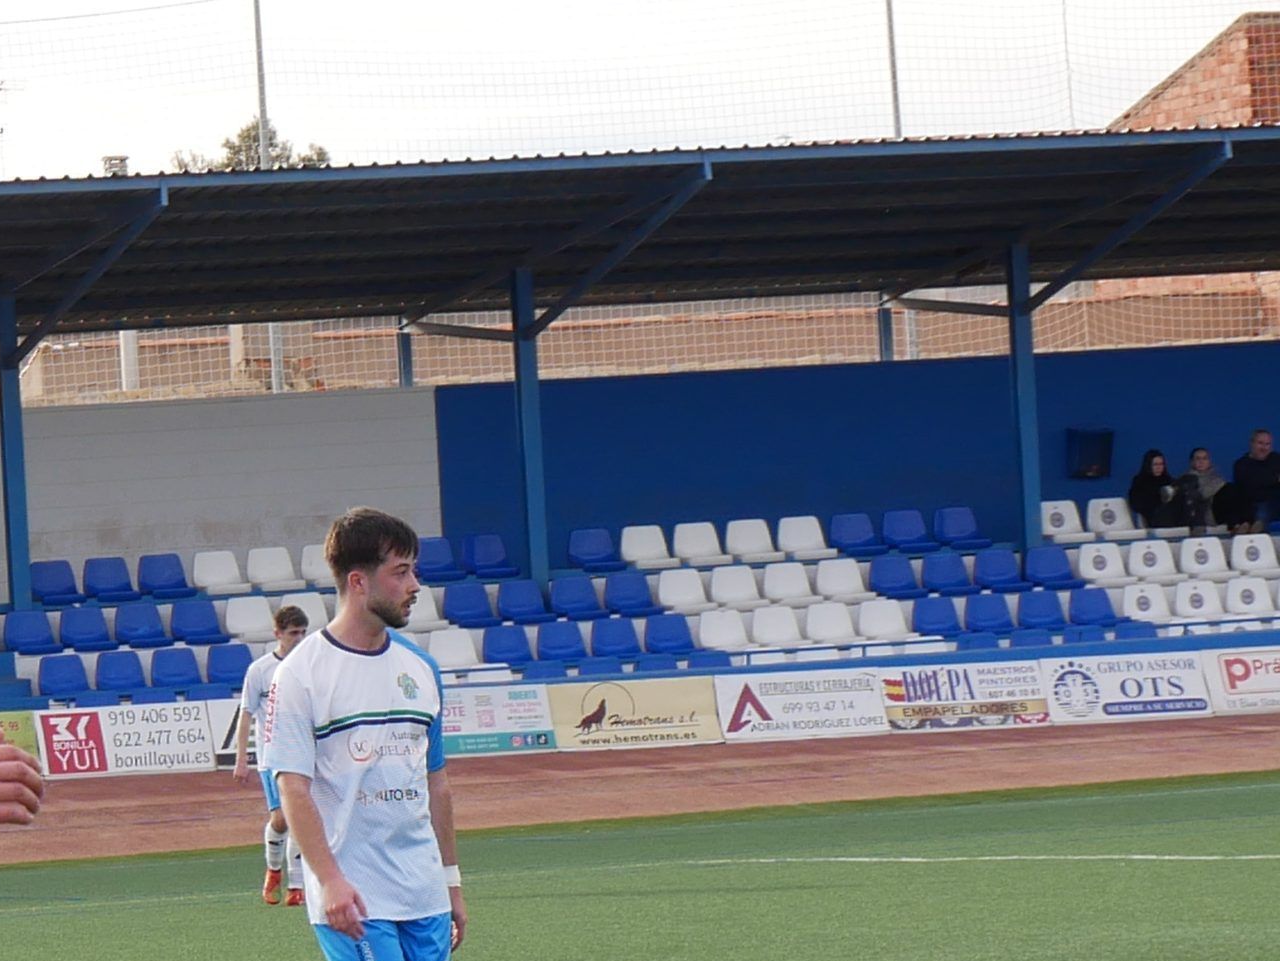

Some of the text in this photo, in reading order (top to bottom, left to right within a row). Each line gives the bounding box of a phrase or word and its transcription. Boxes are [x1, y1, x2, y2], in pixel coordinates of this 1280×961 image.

[977, 666, 1035, 675] MAESTROS
[1097, 658, 1196, 674] GRUPO ASESOR
[759, 681, 814, 693] ESTRUCTURAS
[978, 675, 1037, 686] PINTORES
[1120, 675, 1185, 699] OTS
[108, 706, 201, 725] 919 406 592
[902, 702, 1029, 718] EMPAPELADORES
[53, 741, 96, 750] BONILLA
[113, 728, 205, 747] 622 477 664
[580, 731, 697, 745] www.hemotrans.es
[54, 749, 99, 771] YUI
[114, 751, 210, 768] bonillayui.es
